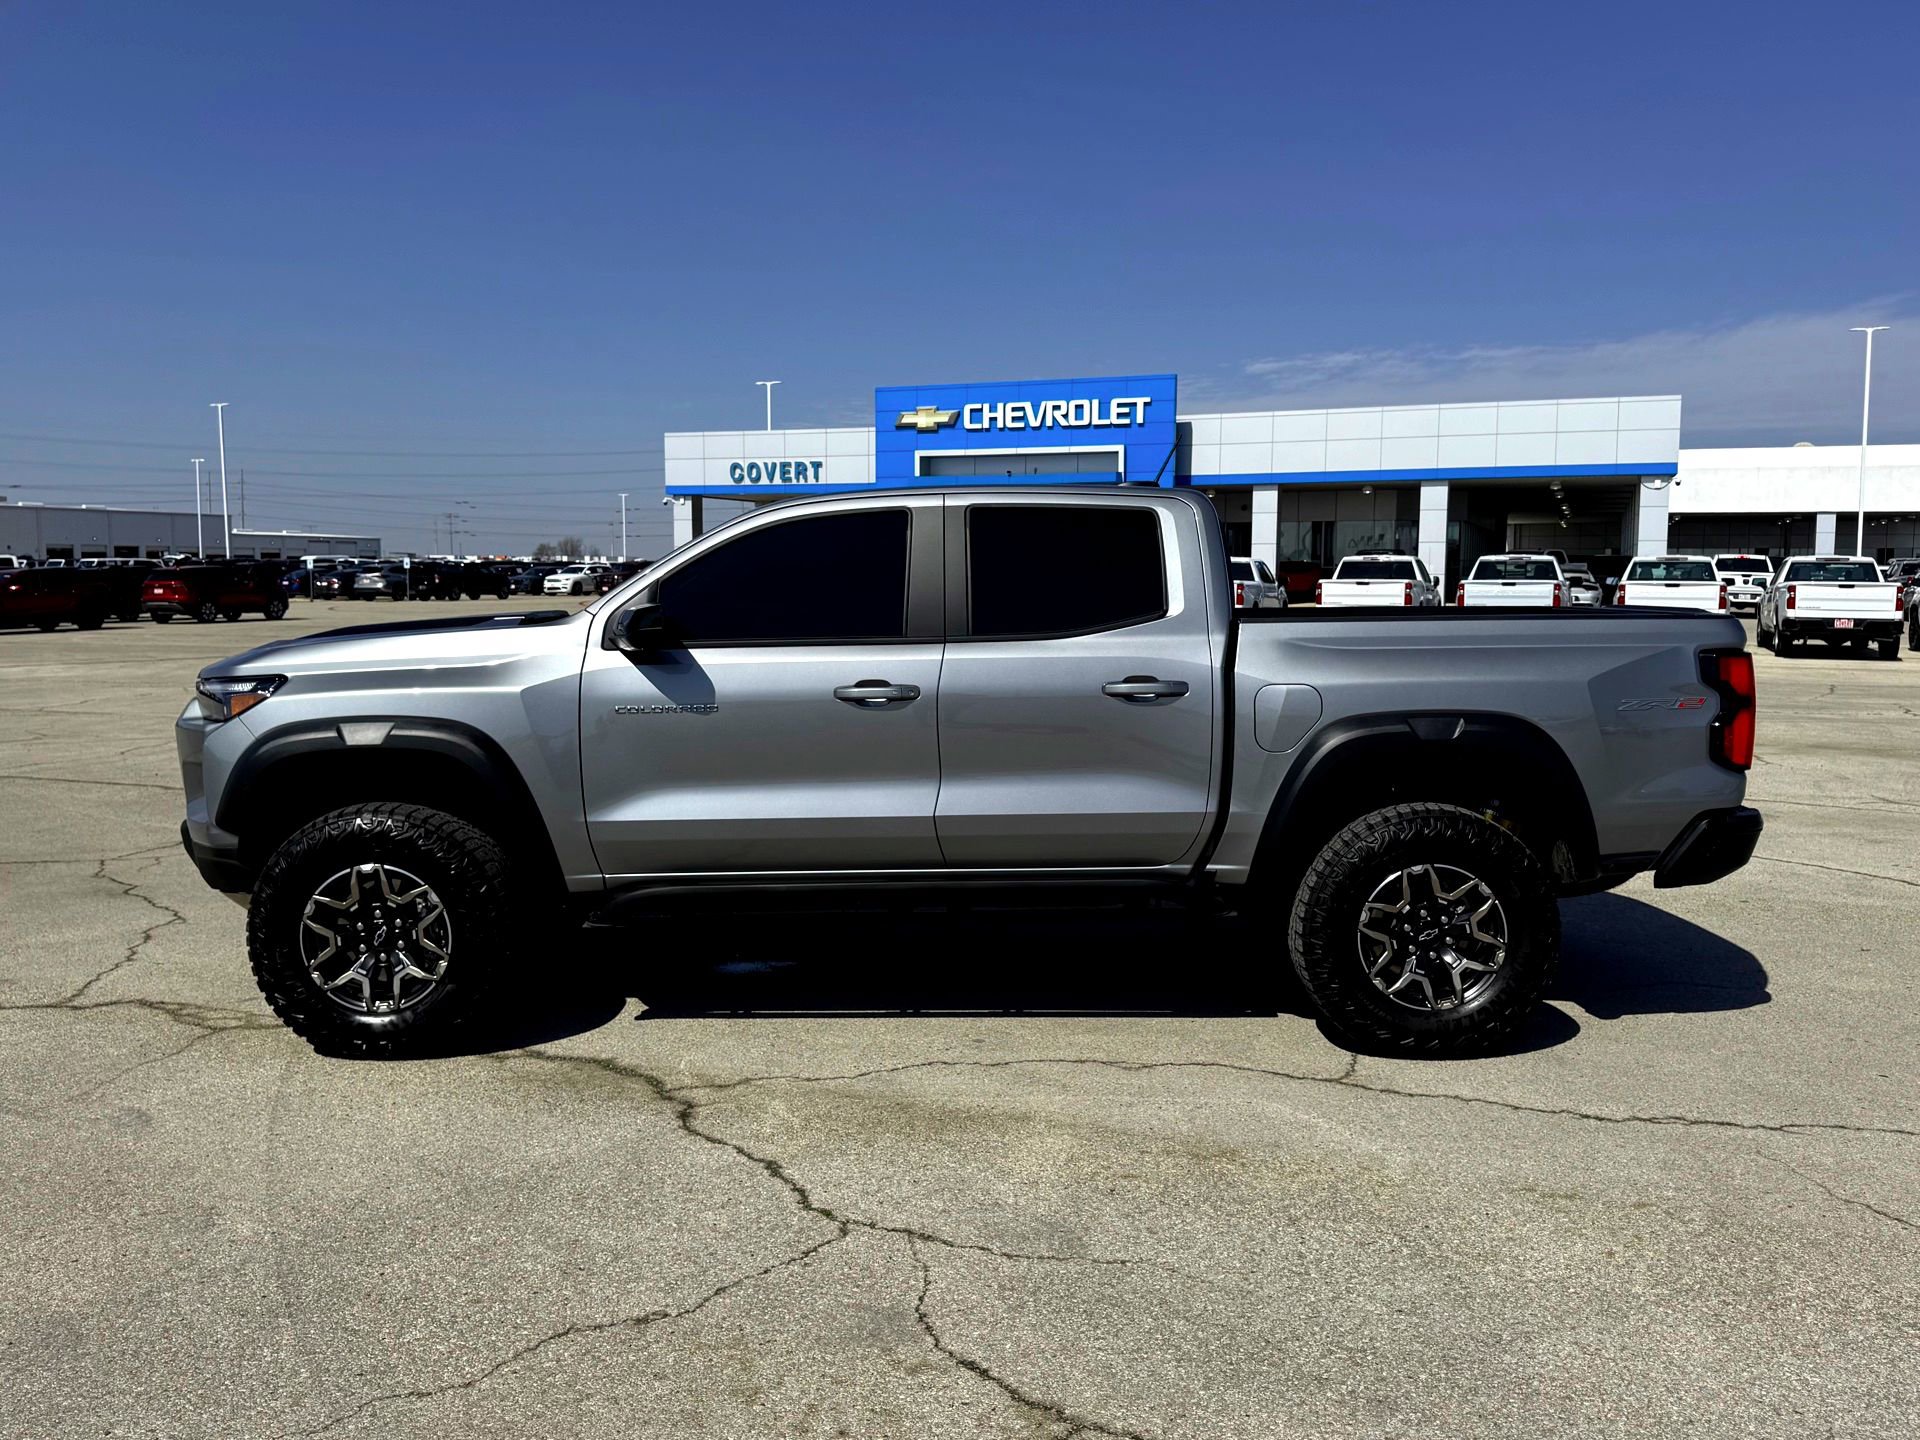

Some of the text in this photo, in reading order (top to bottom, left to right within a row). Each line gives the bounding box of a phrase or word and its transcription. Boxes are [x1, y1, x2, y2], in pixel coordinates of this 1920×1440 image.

[963, 397, 1152, 431] CHEVROLET
[729, 461, 823, 484] COVERT
[614, 704, 719, 715] COLORADO
[1617, 697, 1707, 711] ZR2
